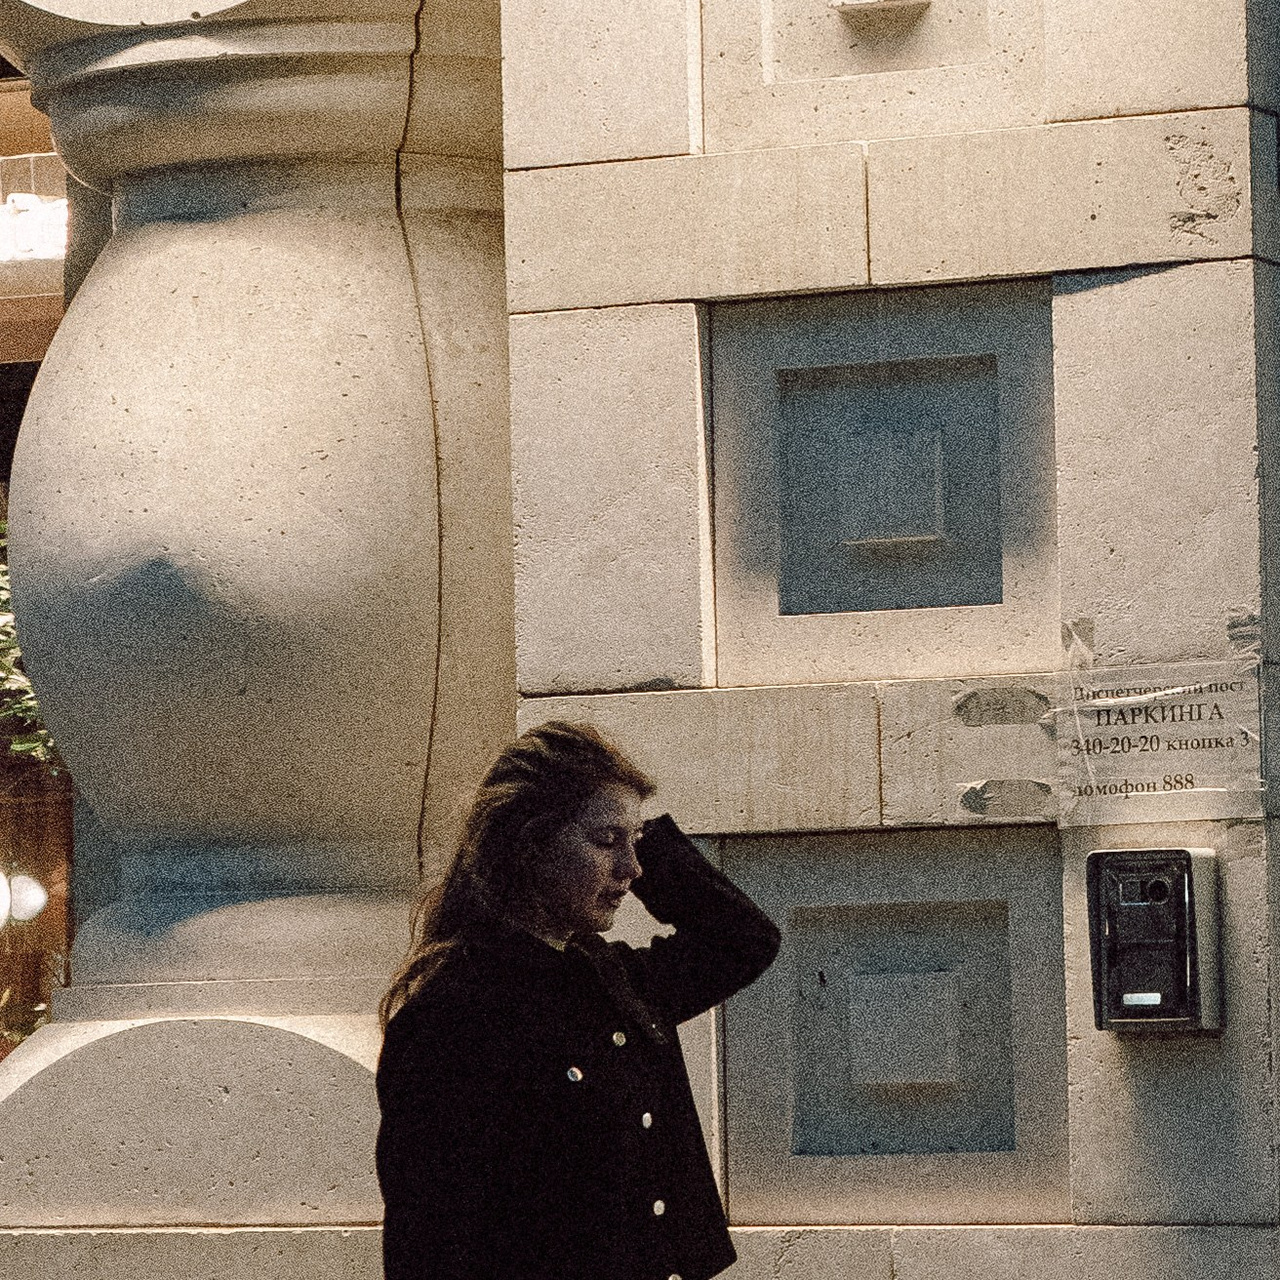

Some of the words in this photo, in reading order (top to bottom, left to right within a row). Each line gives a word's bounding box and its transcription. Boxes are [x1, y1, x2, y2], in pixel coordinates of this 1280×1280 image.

[1095, 702, 1225, 728] ПАРКИНГА
[1071, 734, 1160, 757] 340-20-20
[1165, 736, 1235, 752] кнопка
[1240, 731, 1249, 748] 3
[1162, 773, 1195, 792] 888
